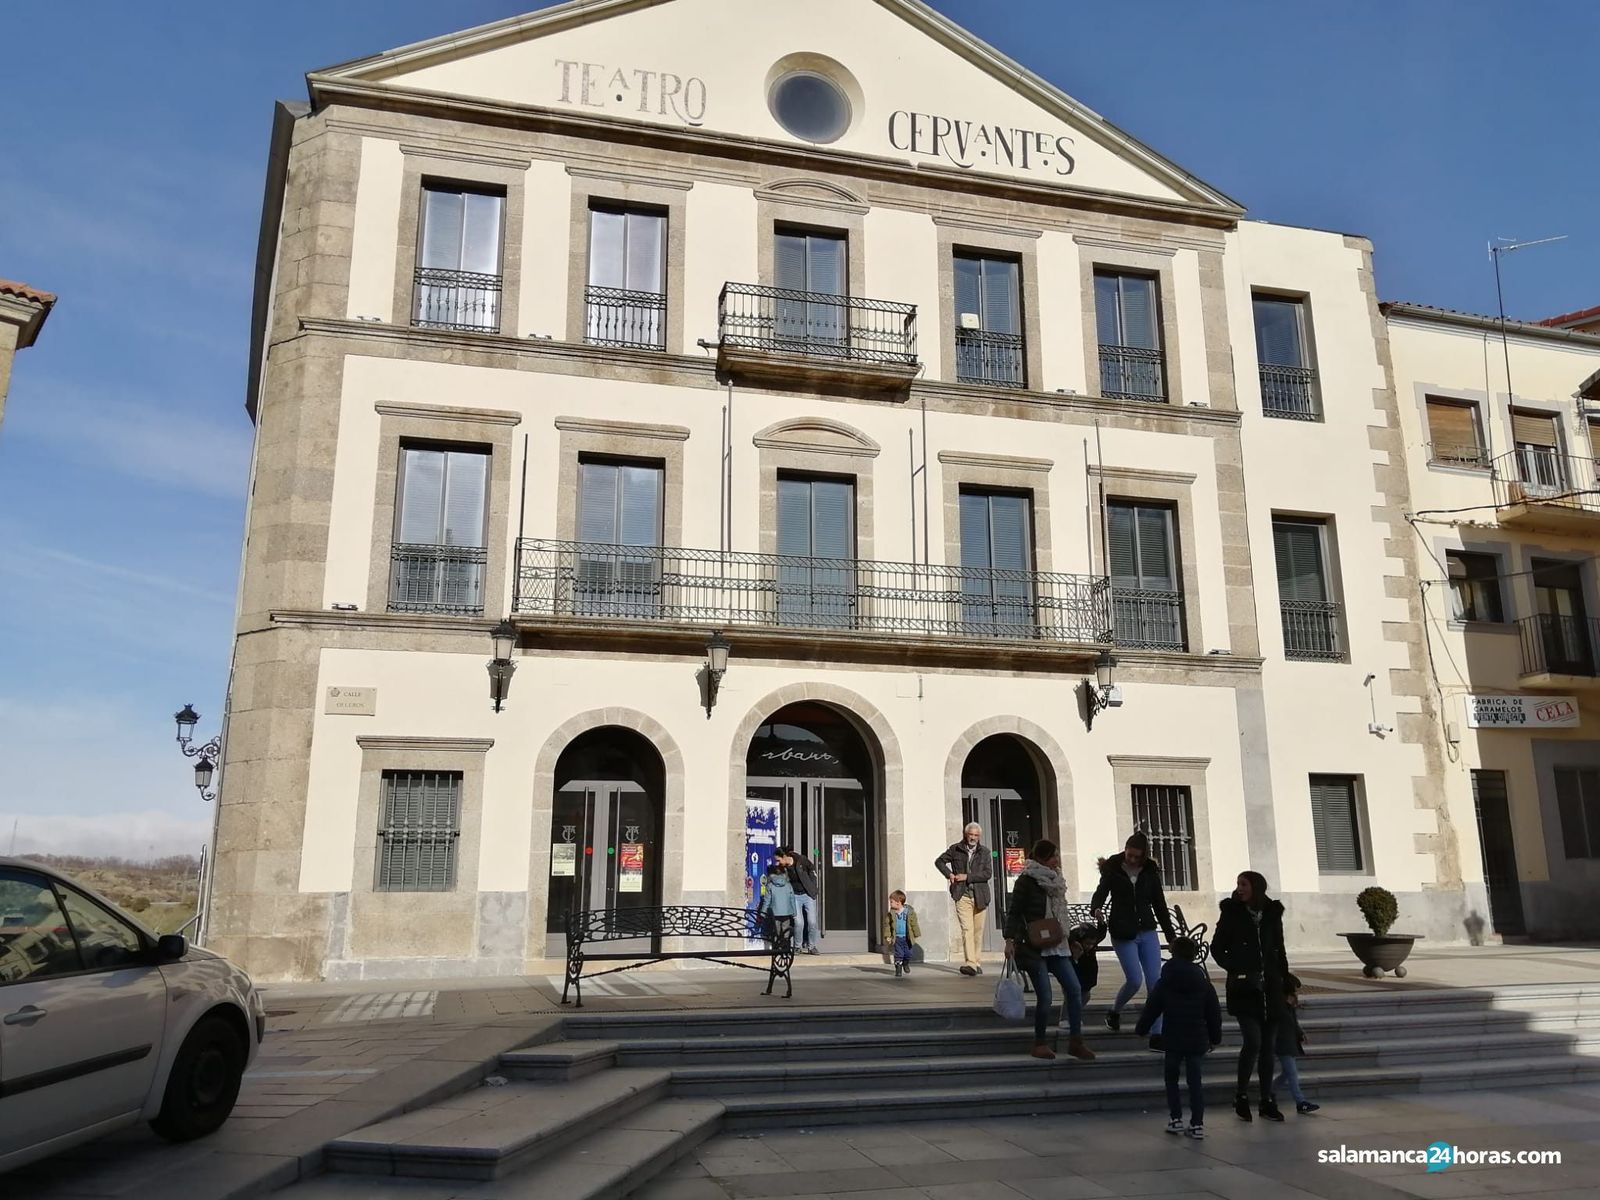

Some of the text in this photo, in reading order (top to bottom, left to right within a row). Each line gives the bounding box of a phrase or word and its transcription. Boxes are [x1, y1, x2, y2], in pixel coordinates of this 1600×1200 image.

[554, 59, 1075, 175] TEATRO CERVANTES
[1472, 698, 1507, 706] FABRICA
[1536, 702, 1574, 722] CELA
